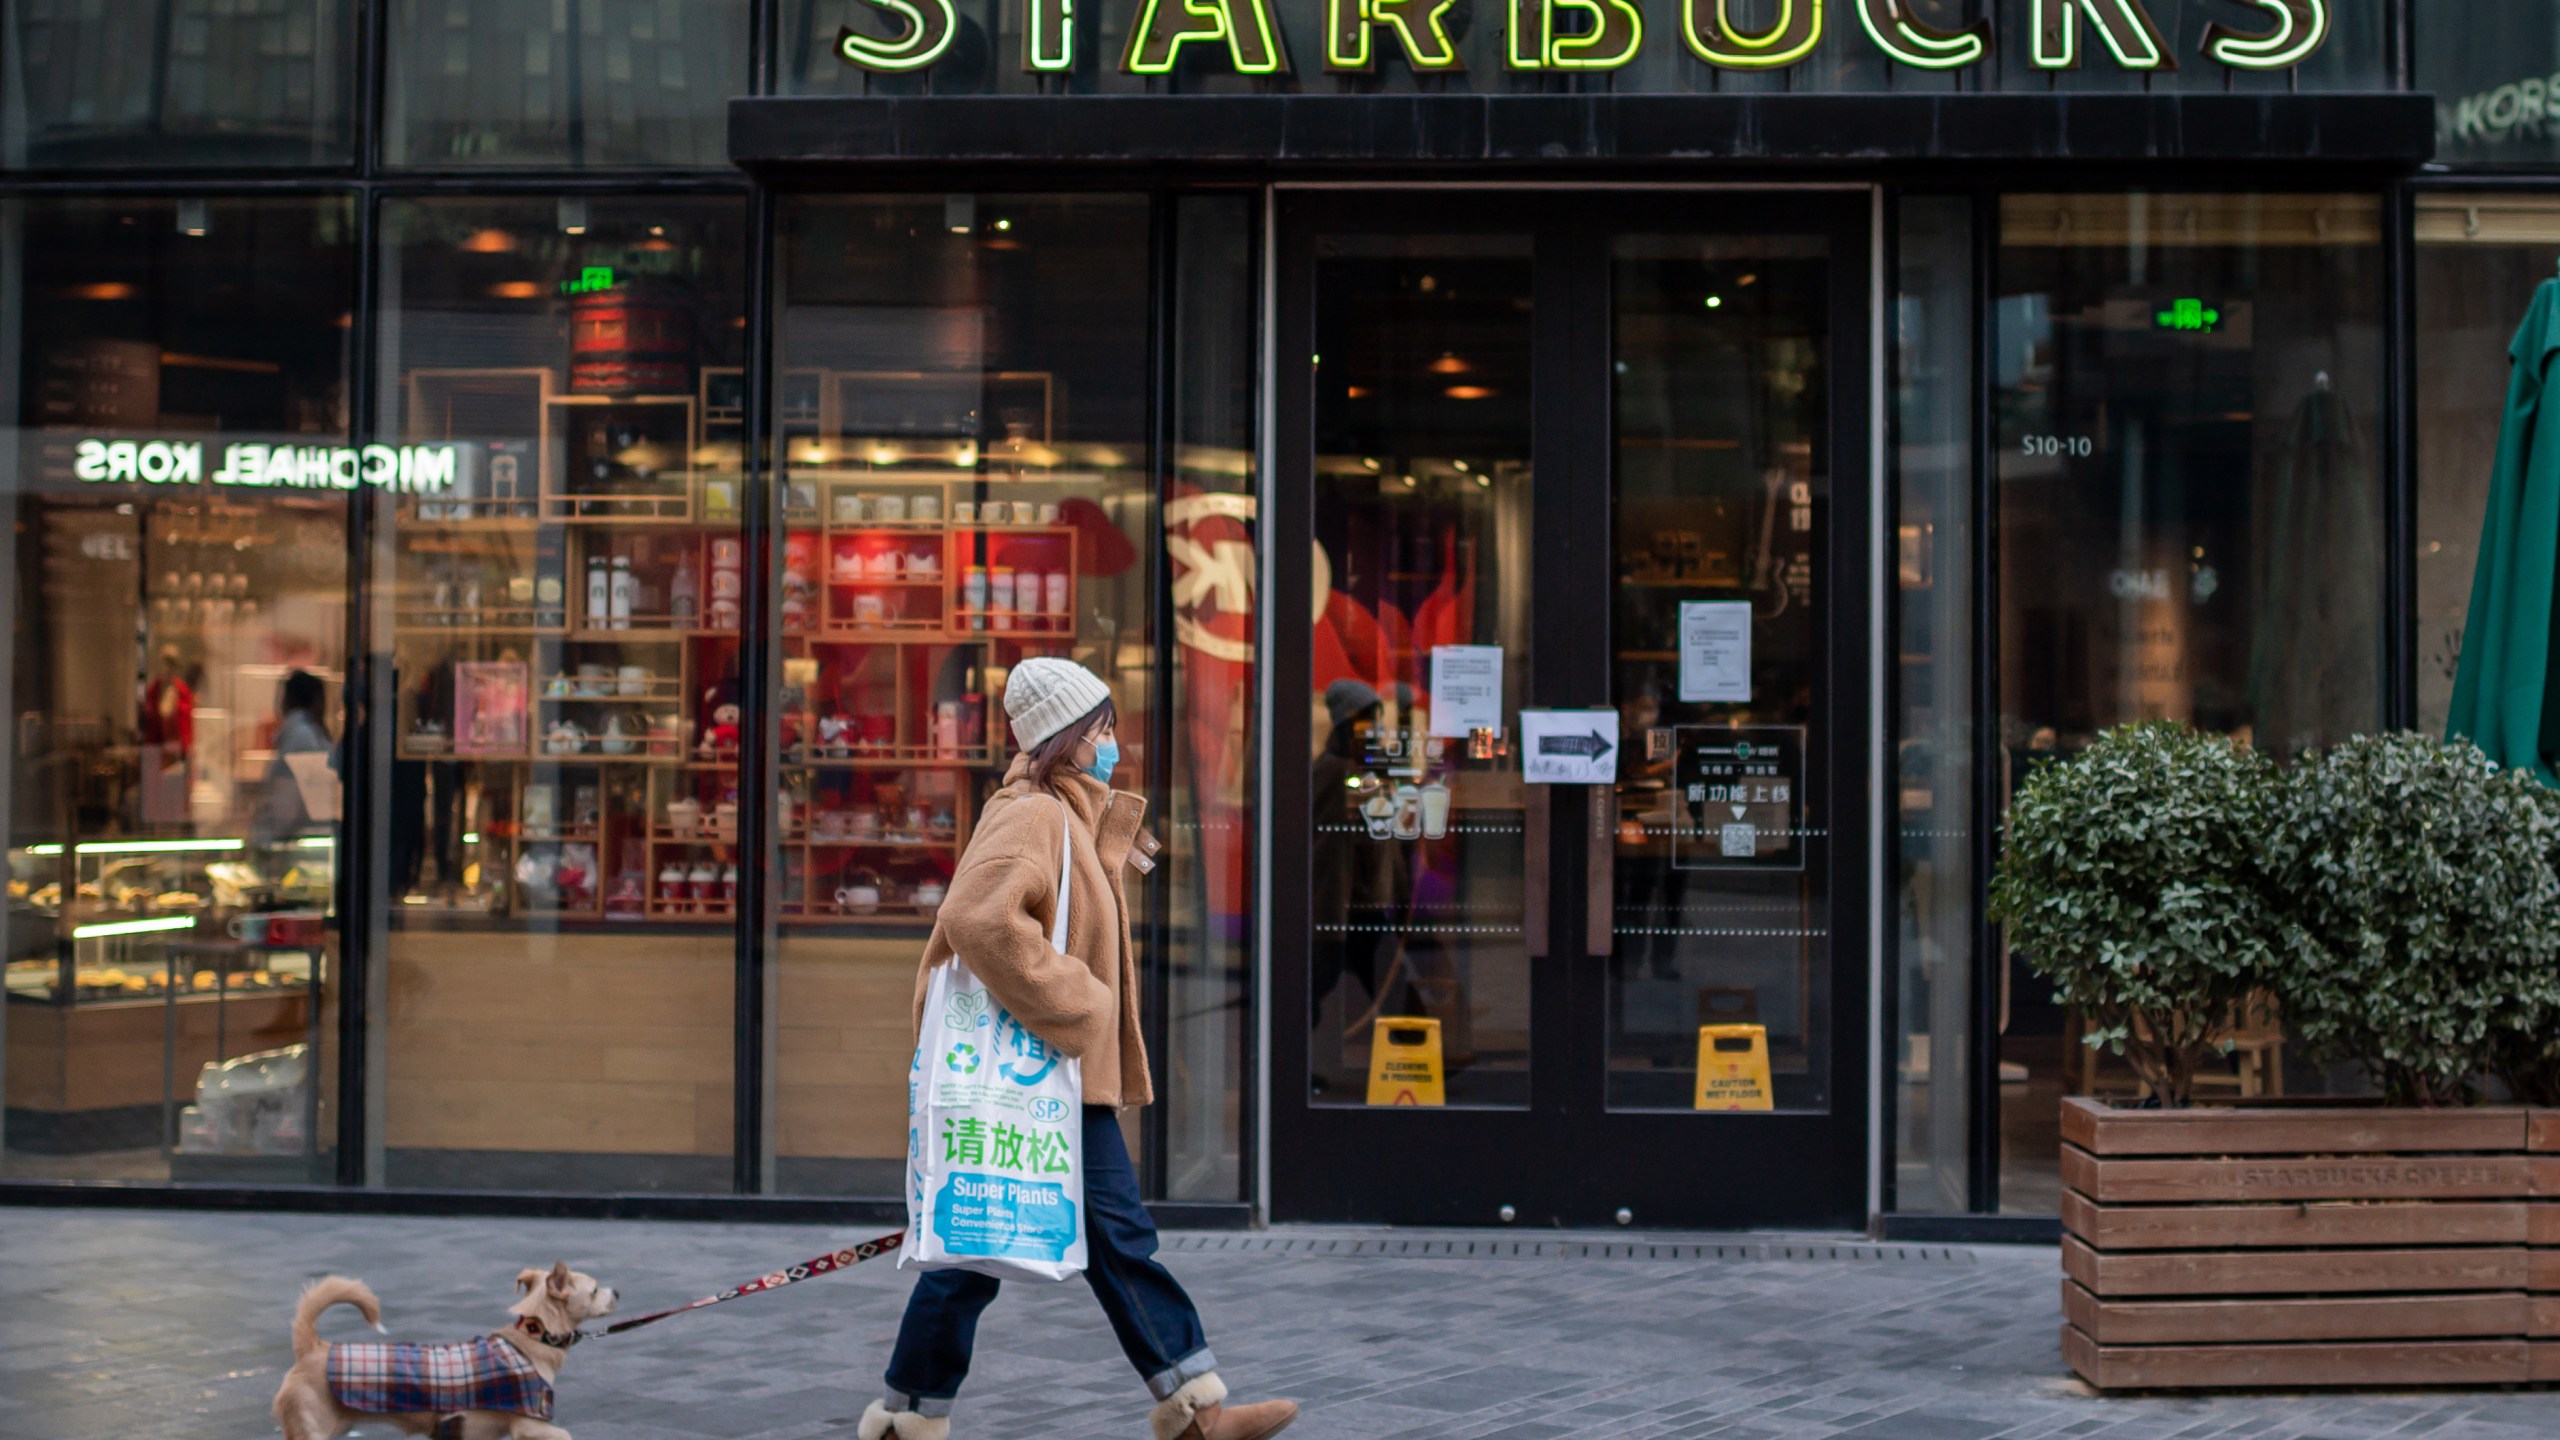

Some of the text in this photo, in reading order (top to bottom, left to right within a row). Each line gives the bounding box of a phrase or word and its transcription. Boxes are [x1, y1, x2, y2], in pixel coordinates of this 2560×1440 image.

[2022, 434, 2092, 457] S10-10
[1688, 783, 1790, 803] 新功能上线
[1711, 1079, 1756, 1088] CAUTION
[942, 1117, 1070, 1174] 请放松
[2244, 1164, 2499, 1187] STARBUCKS COFFEE
[953, 1176, 1058, 1206] Super Plants
[952, 1203, 1014, 1219] Super Plants
[951, 1216, 1043, 1234] Convenience Store
